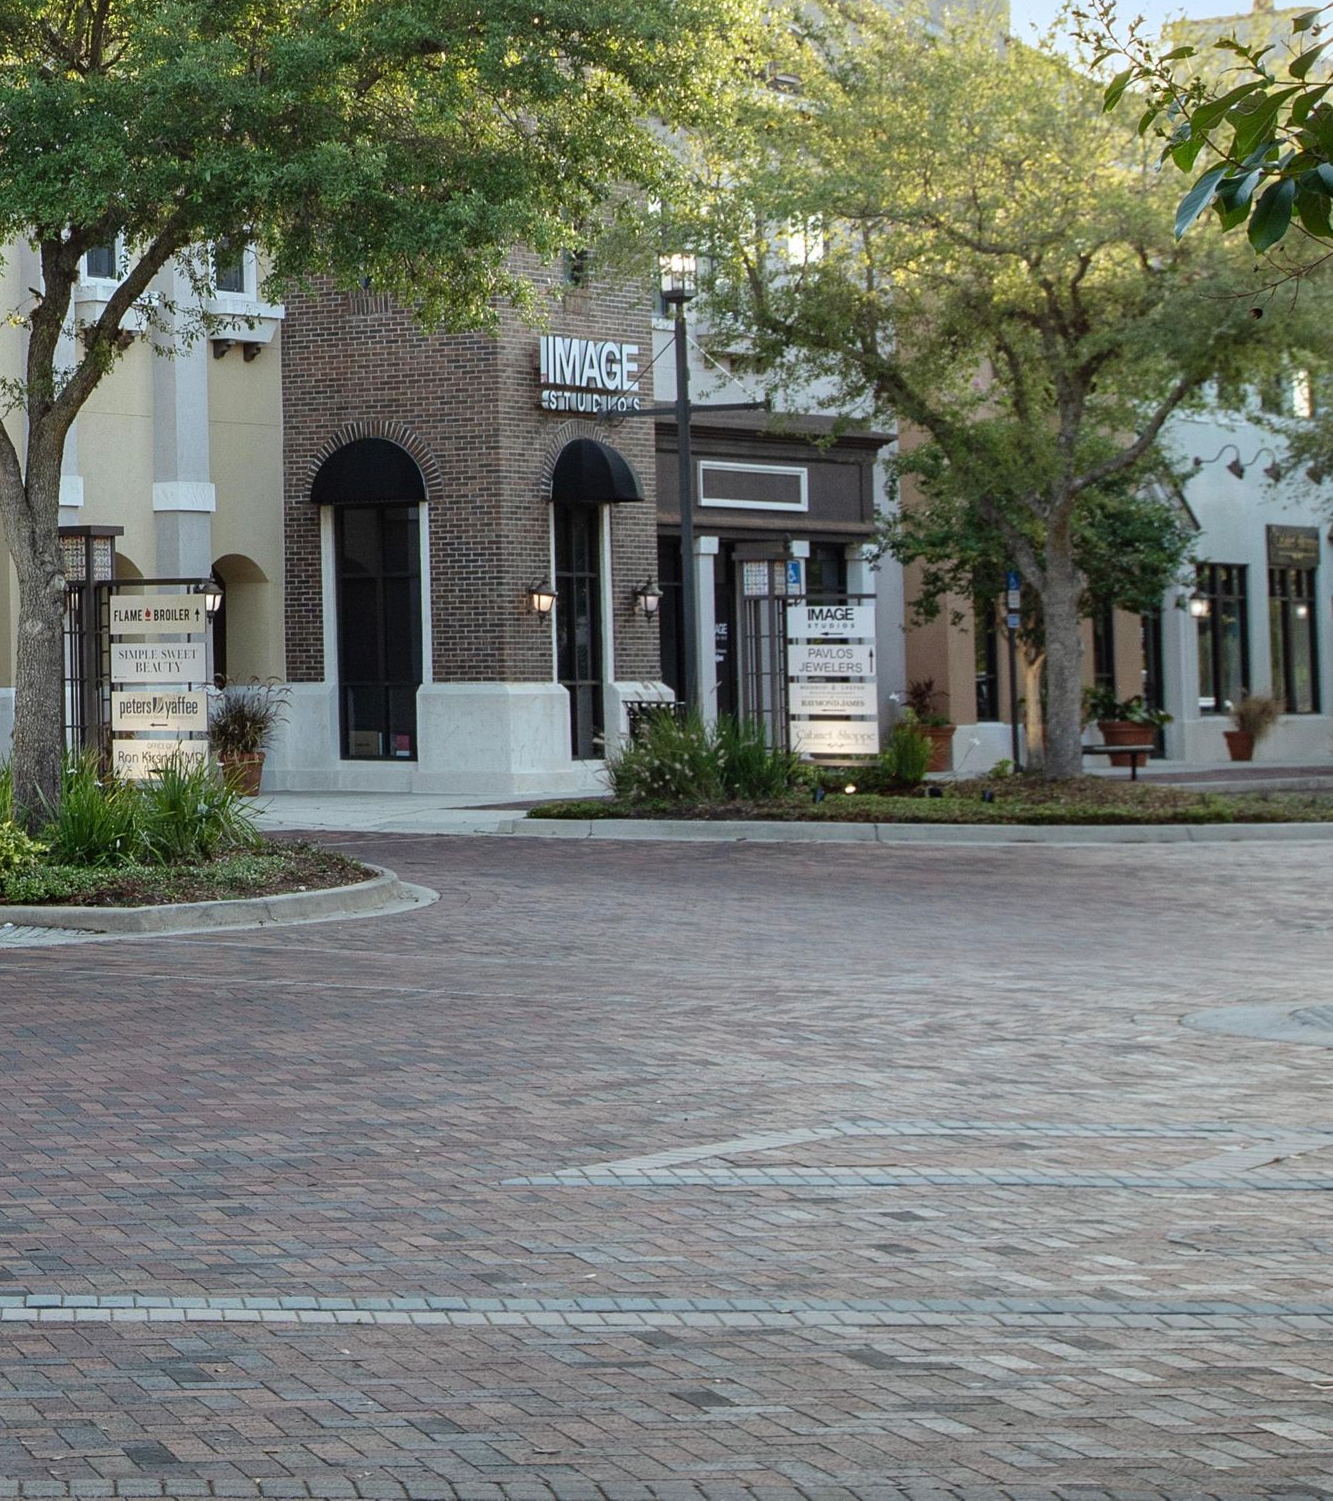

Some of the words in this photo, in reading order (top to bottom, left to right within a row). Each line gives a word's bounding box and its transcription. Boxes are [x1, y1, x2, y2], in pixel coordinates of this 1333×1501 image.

[540, 335, 639, 391] IMAGE
[543, 390, 641, 413] STUDIOS
[114, 609, 143, 622] FLAME
[153, 608, 190, 621] BROILER
[807, 607, 855, 621] IMAGE
[118, 649, 157, 660] SIMPLE
[161, 649, 198, 660] SWEET
[808, 648, 854, 659] PAVLOS
[135, 661, 183, 673] BEAUTY
[799, 662, 863, 673] JEWELERS
[119, 698, 152, 719] peters
[164, 696, 198, 719] yaffee
[118, 750, 139, 764] Ron
